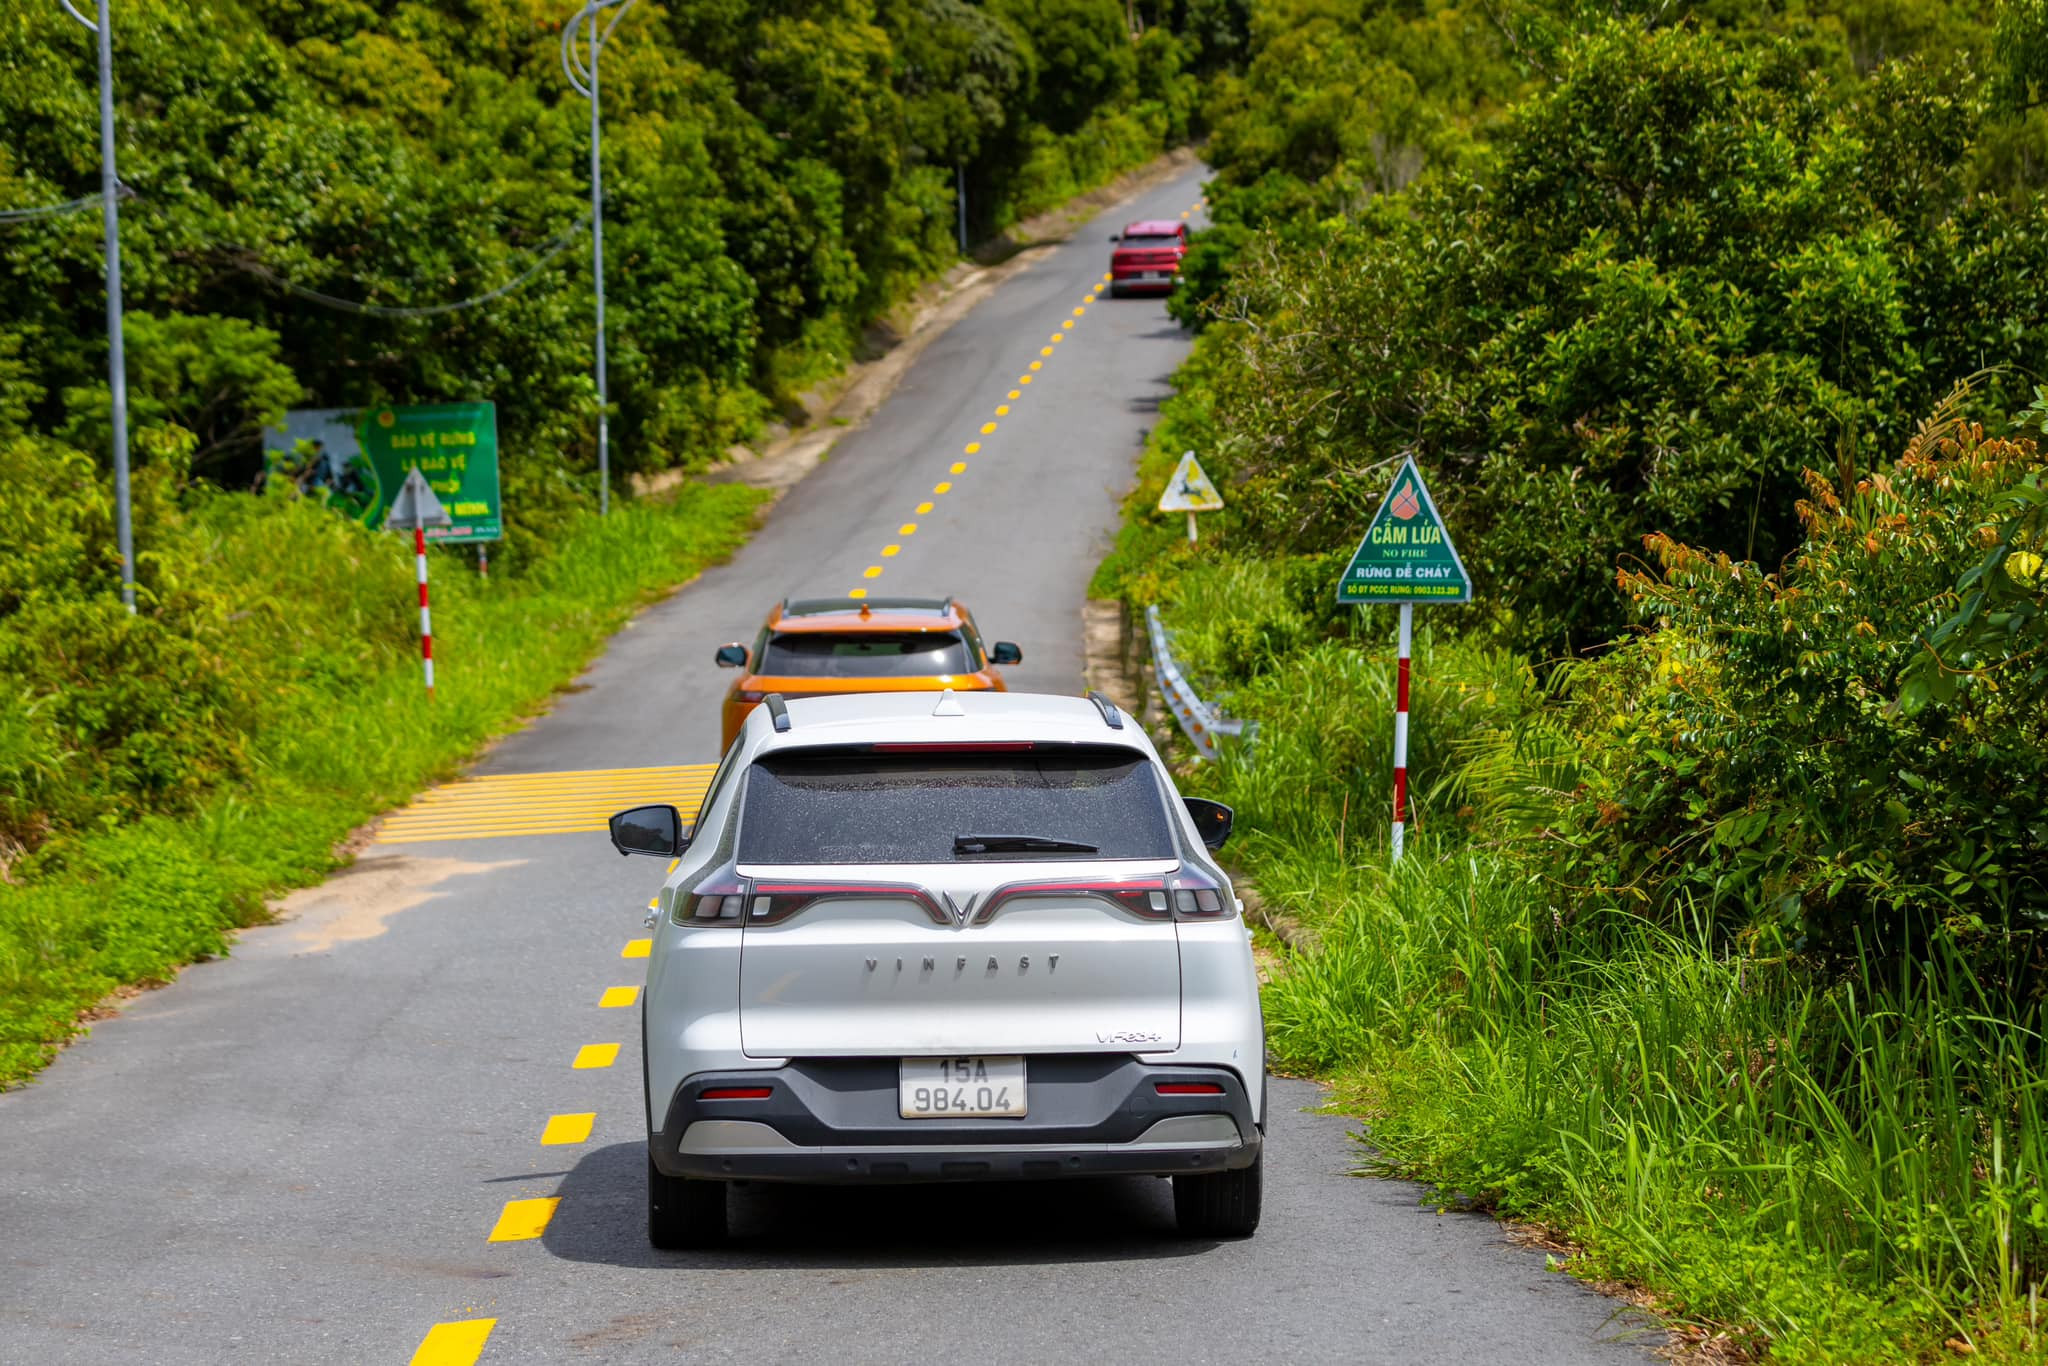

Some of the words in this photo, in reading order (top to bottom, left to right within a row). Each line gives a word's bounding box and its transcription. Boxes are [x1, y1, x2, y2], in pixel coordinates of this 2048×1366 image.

[1372, 518, 1407, 544] CẤM
[1411, 518, 1442, 544] LỬA
[1382, 549, 1399, 558] NO
[1401, 549, 1428, 558] FIRE
[1416, 563, 1452, 578] CHÁY
[866, 954, 1059, 971] VINFAST
[940, 1060, 988, 1084] 15A
[914, 1086, 1011, 1112] 984.04
